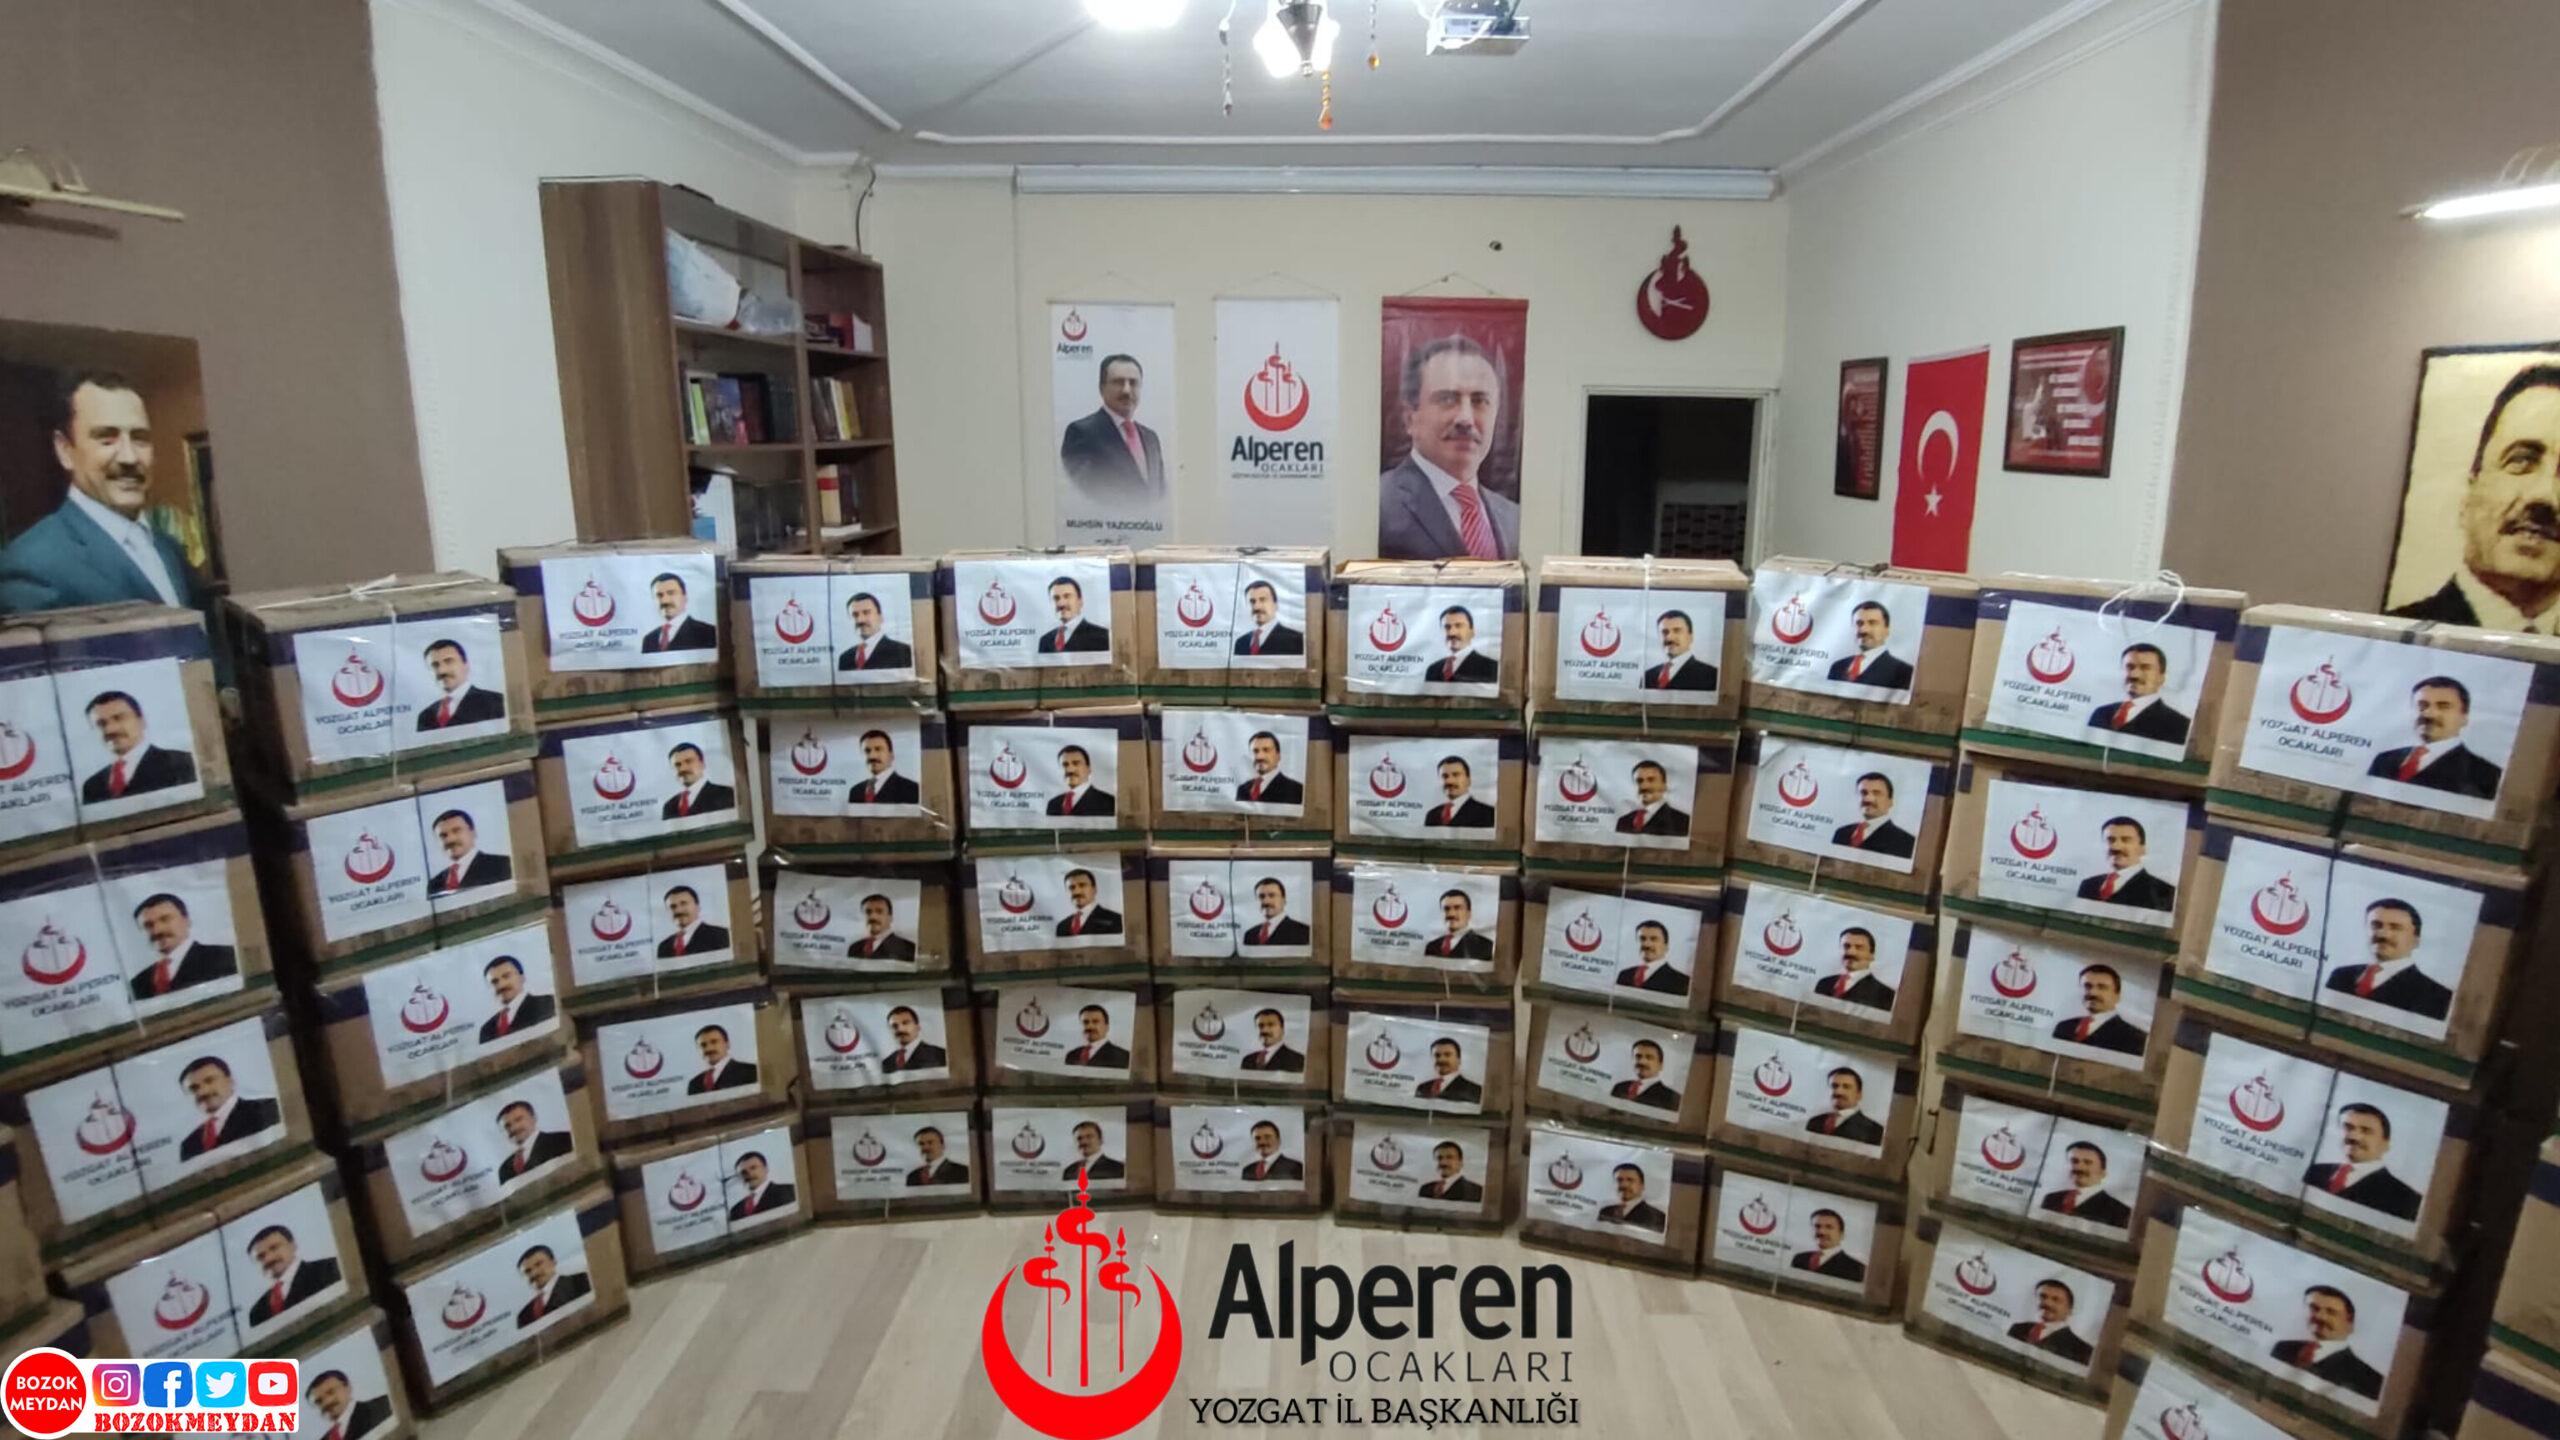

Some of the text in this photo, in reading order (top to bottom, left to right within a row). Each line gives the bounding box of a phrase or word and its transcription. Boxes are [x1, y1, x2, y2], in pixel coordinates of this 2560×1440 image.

[1231, 435, 1323, 467] Alperen
[1261, 463, 1323, 472] OCAKLARI
[2044, 688, 2091, 702] ALPEREN
[2017, 696, 2069, 712] OCAKLARI
[2312, 729, 2372, 747] ALPEREN
[2278, 737, 2343, 757] OCAKLARI
[2031, 862, 2077, 876] ALPEREN
[2006, 871, 2056, 884] OCAKLARI
[2241, 945, 2302, 968] OCAKLARI
